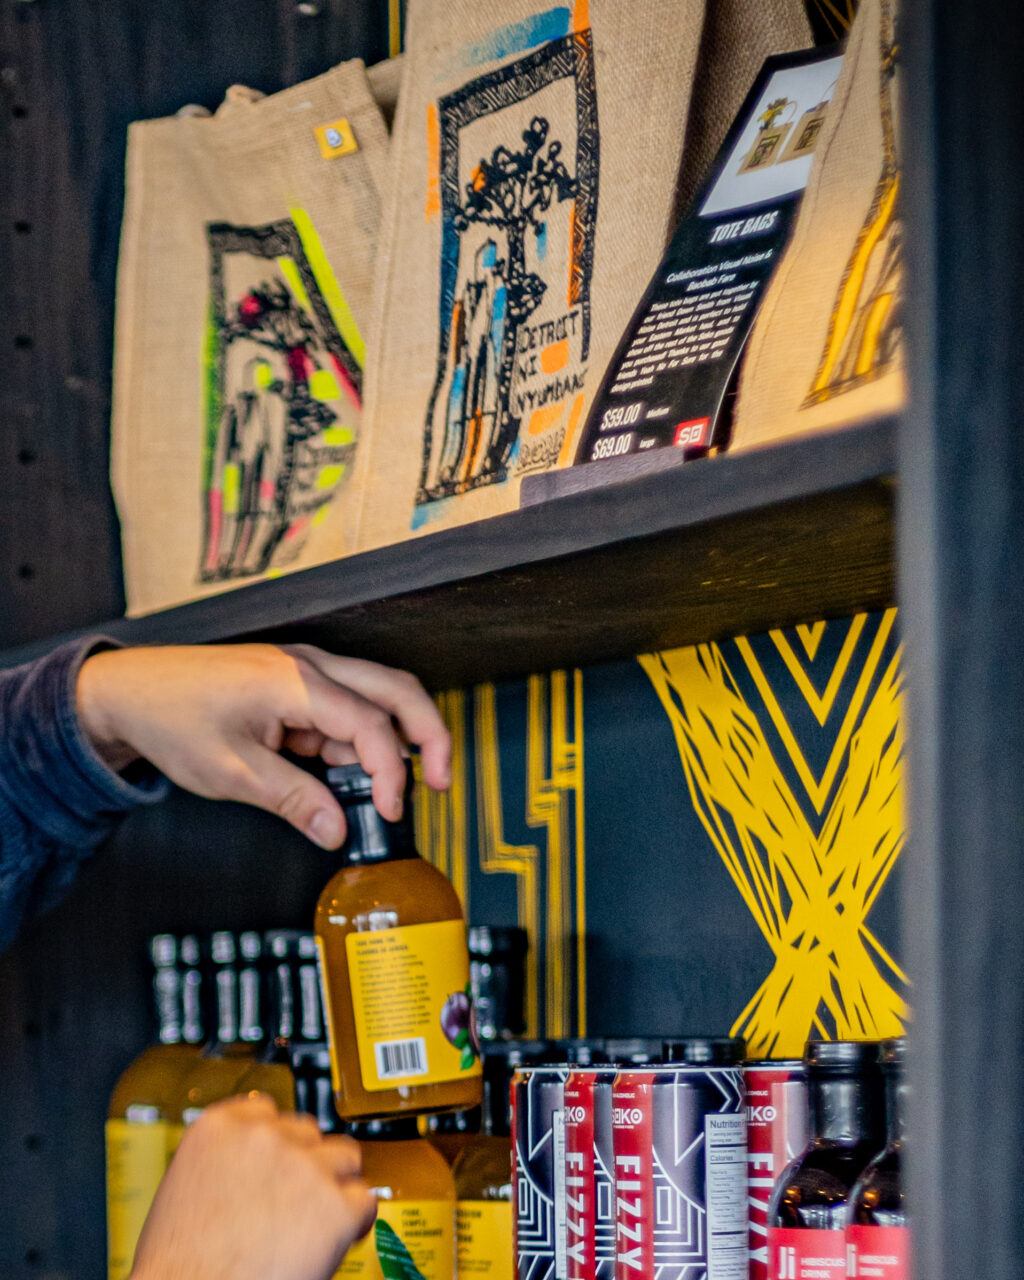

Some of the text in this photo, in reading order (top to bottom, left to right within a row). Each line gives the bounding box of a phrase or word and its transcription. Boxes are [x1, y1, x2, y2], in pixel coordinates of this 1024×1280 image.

[709, 210, 779, 243] TOTE BAGS
[666, 249, 772, 283] Collaboration Visual Noise &
[686, 274, 736, 291] Baobab Fare
[600, 402, 643, 431] $59.00
[591, 432, 633, 461] $69.00
[710, 1120, 741, 1129] Nutrition
[565, 1152, 585, 1265] FIZZY
[616, 1155, 643, 1270] FIZZY
[800, 1257, 846, 1267] HIBISCUS
[800, 1269, 831, 1279] DRINK
